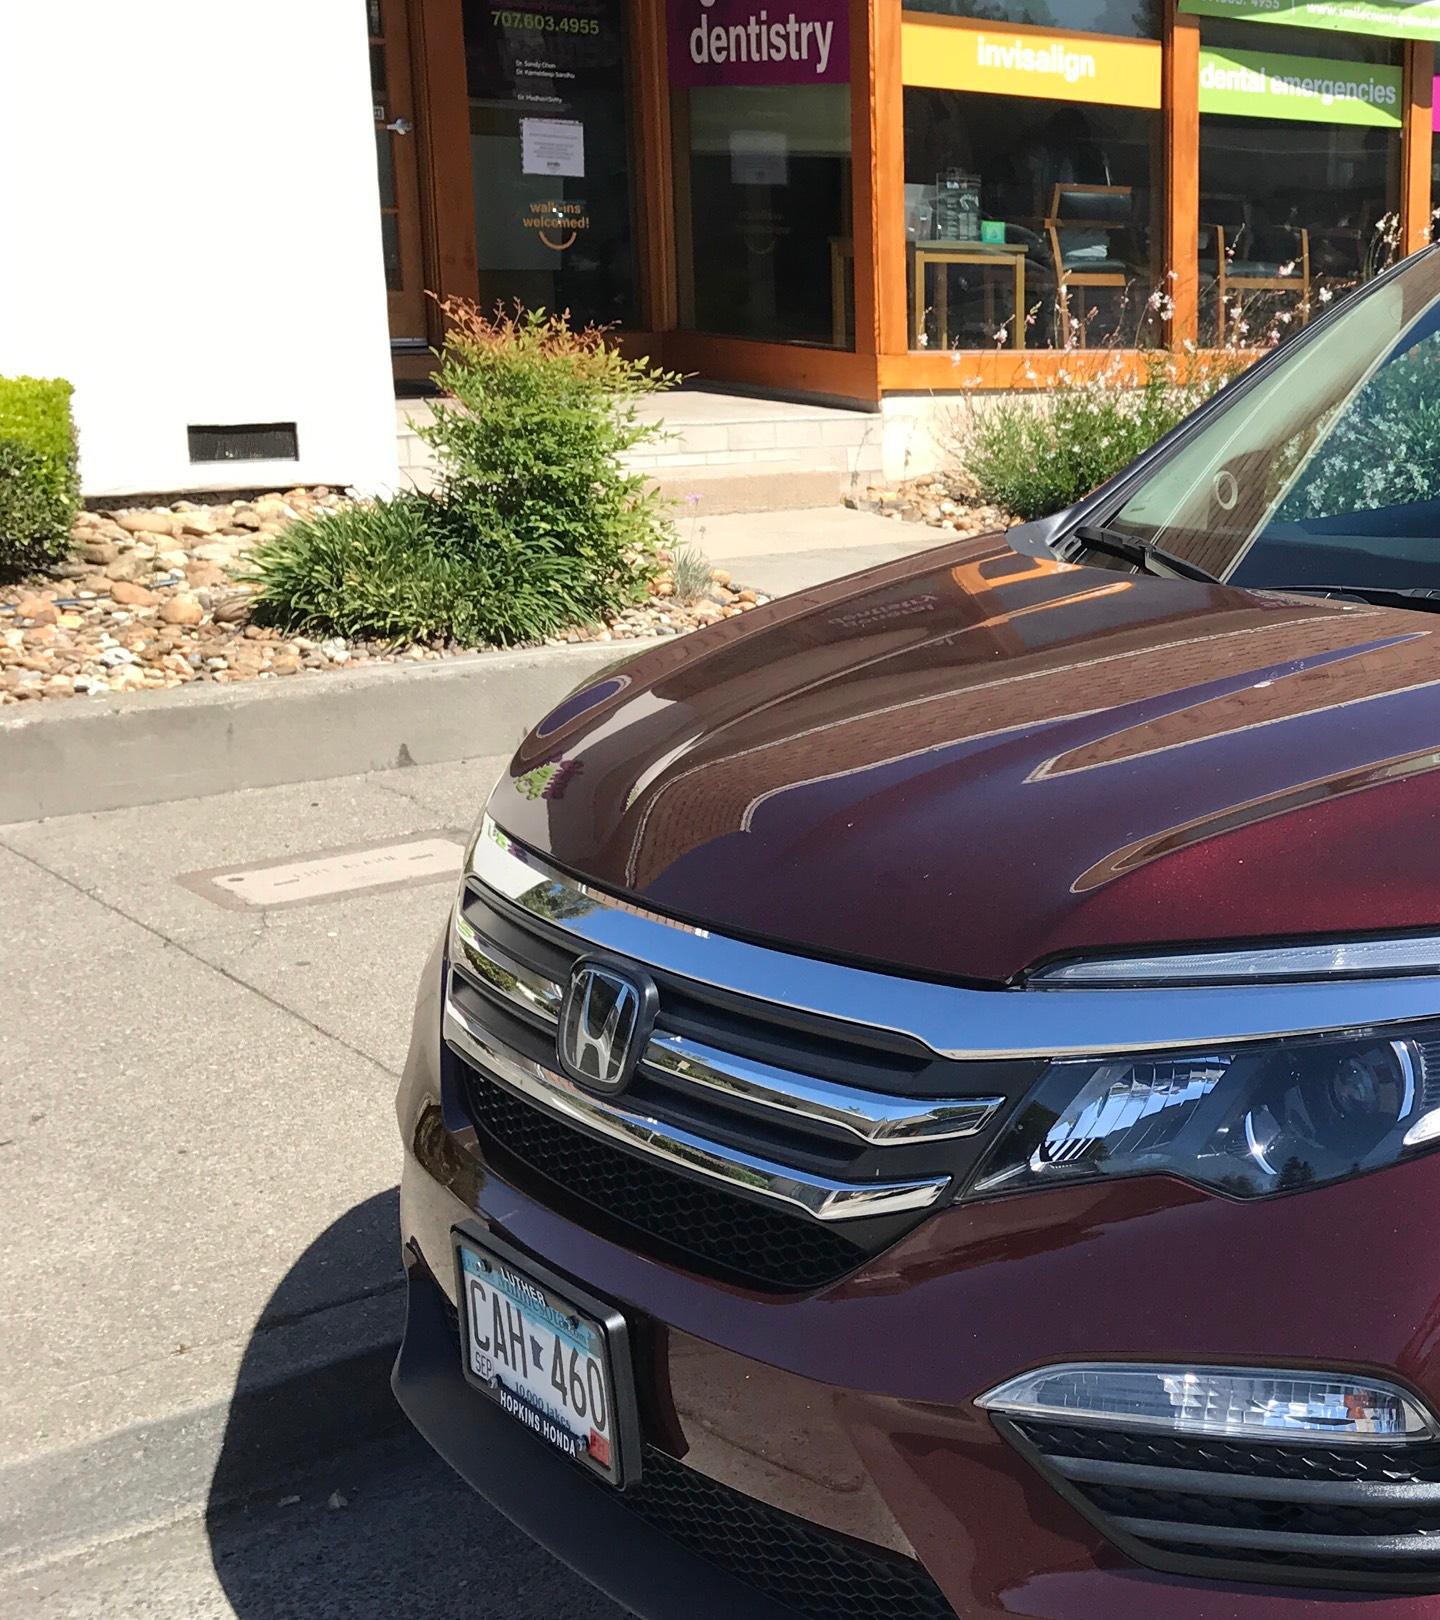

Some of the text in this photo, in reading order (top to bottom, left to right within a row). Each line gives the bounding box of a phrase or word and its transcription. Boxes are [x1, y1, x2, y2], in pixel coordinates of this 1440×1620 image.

[491, 11, 600, 35] 707.603.4955
[690, 10, 834, 74] dentistry
[977, 34, 1096, 83] invisalign
[1200, 61, 1397, 106] dental emergencies
[522, 216, 590, 229] welcomed!
[500, 1267, 546, 1307] LUTHER
[471, 1279, 606, 1432] CAH 460
[475, 1351, 492, 1377] SEP
[500, 1389, 541, 1432] HOPKINS
[543, 1420, 576, 1457] HONDA
